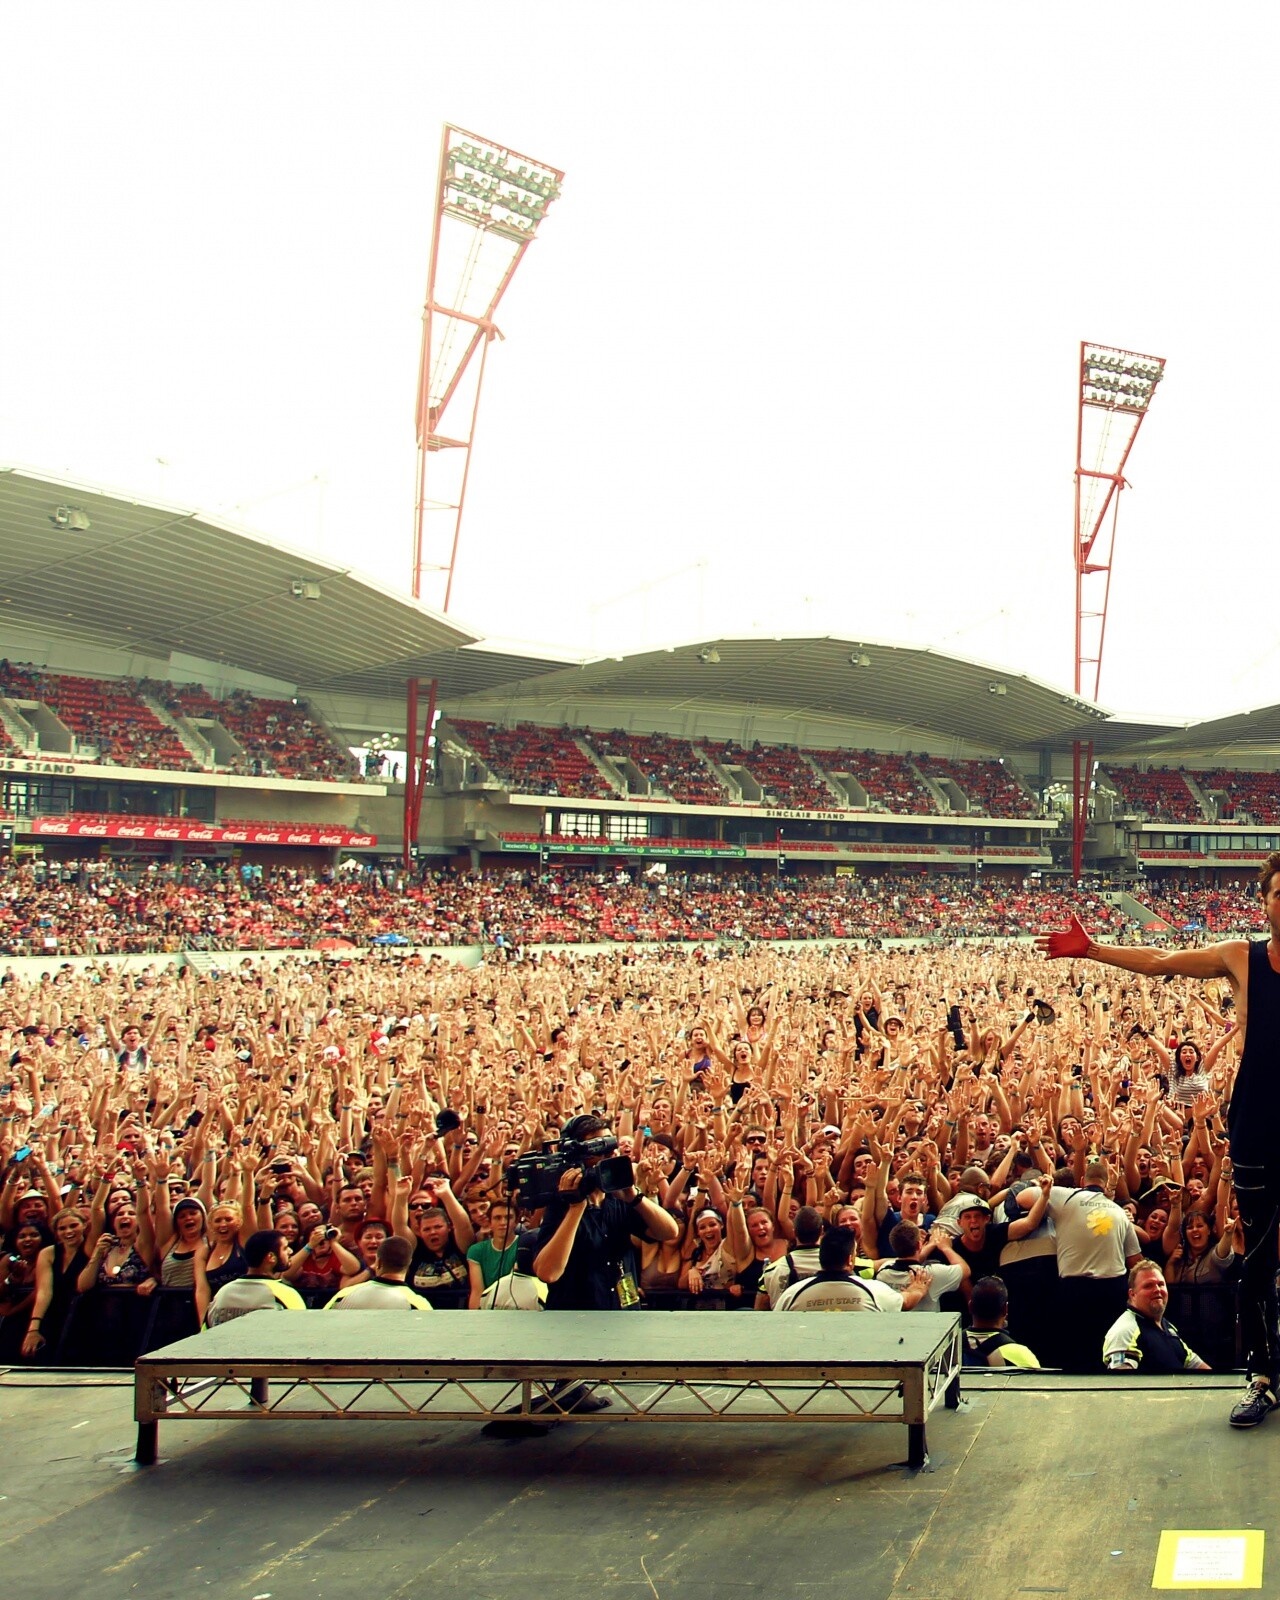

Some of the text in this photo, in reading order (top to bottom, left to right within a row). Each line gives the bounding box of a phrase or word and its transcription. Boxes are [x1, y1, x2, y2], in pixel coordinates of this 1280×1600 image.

[26, 762, 76, 774] STAND
[766, 810, 845, 820] SINCLAIR STAND
[806, 1297, 862, 1307] EVENT STAFF
